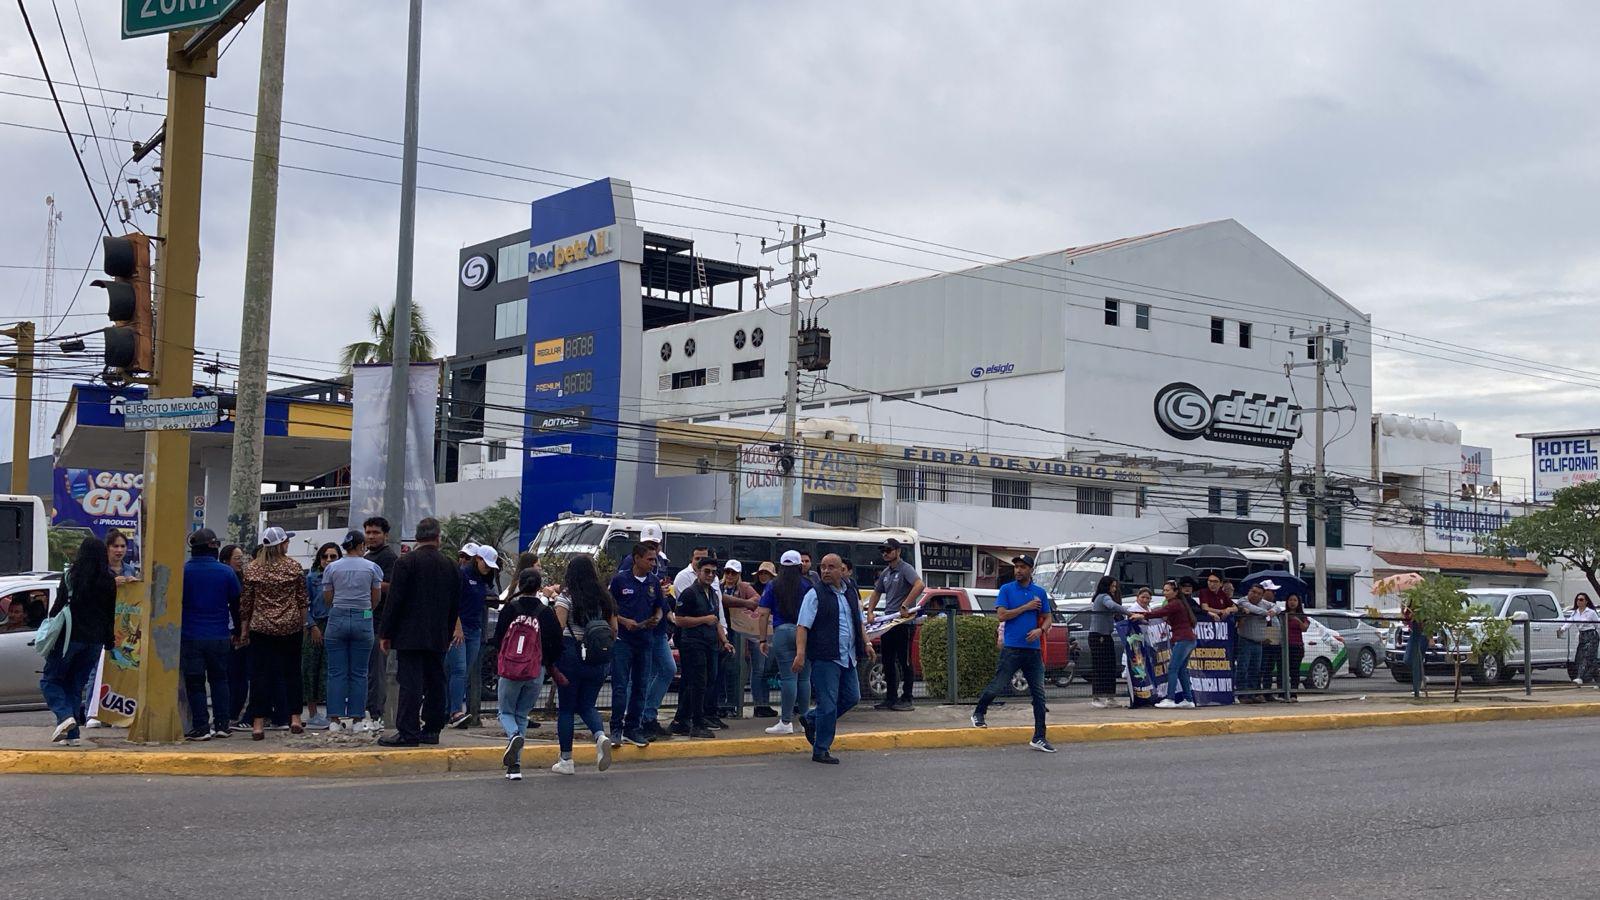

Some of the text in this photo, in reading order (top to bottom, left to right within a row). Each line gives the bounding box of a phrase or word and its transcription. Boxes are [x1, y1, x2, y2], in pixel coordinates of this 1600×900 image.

[537, 346, 562, 356] REGULAR
[535, 381, 561, 392] PREMIUM
[125, 403, 169, 414] EJERCITO
[171, 400, 217, 412] MEXICANO
[1213, 391, 1302, 437] elsiglo
[1537, 440, 1598, 456] HOTEL
[989, 456, 1021, 471] DE
[1539, 456, 1598, 472] CALIFORNIA
[101, 693, 136, 716] UAS
